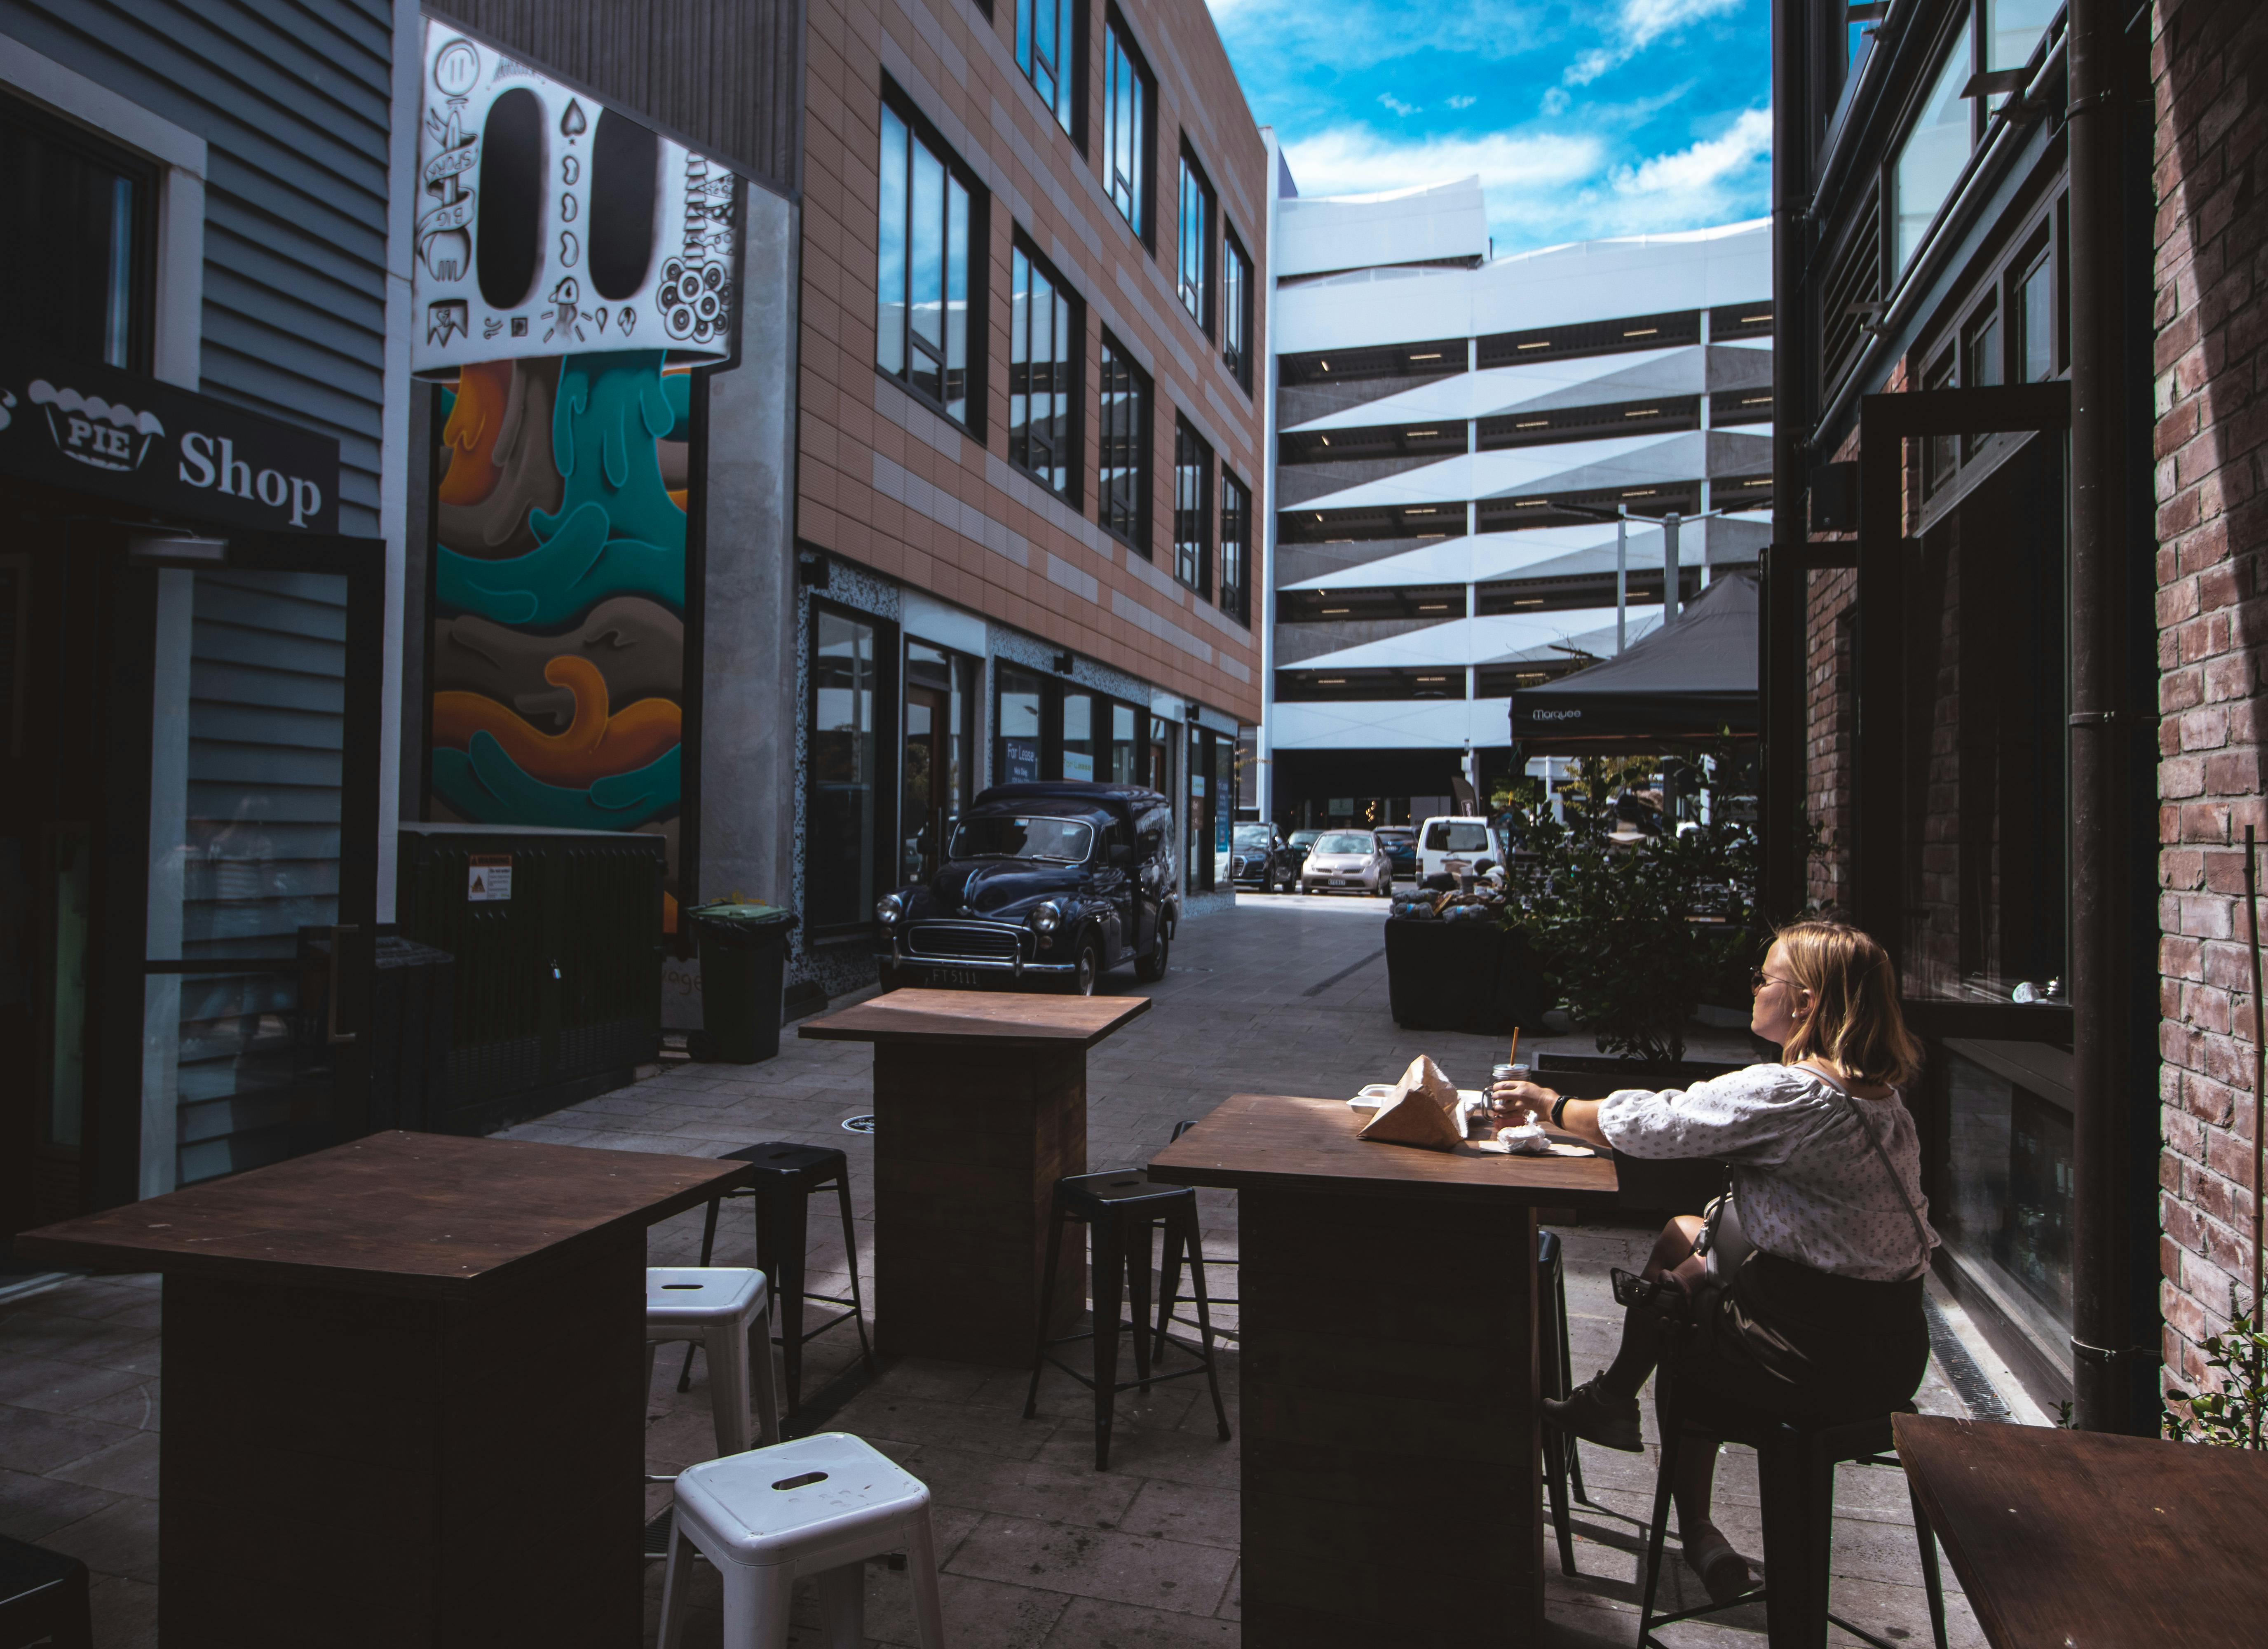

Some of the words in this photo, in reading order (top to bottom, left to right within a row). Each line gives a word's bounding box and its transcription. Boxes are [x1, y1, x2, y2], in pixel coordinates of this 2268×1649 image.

[68, 417, 130, 459] PIE
[179, 431, 321, 529] Shop
[1007, 743, 1017, 759] For
[1018, 745, 1034, 762] Lease
